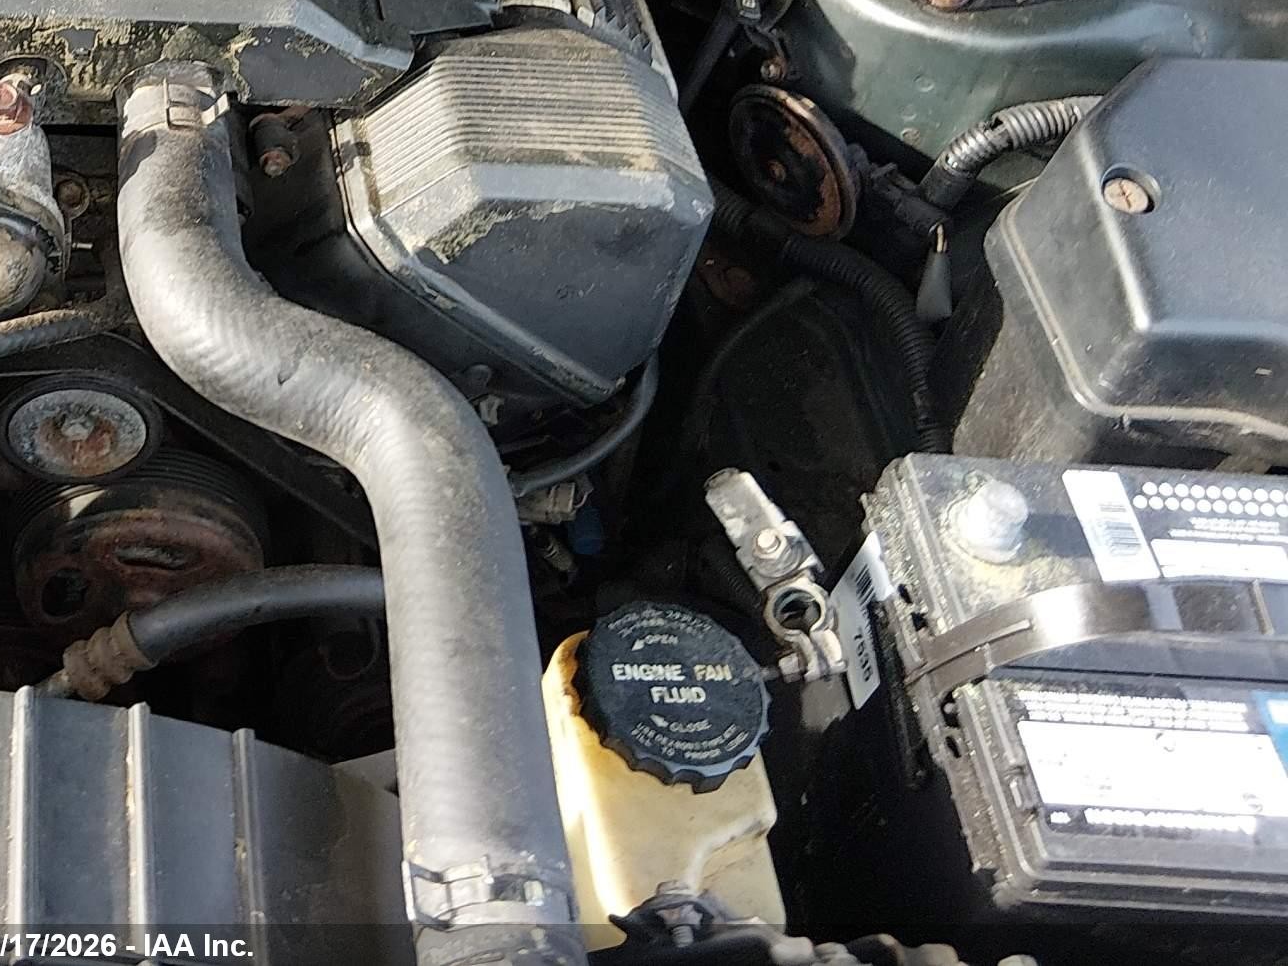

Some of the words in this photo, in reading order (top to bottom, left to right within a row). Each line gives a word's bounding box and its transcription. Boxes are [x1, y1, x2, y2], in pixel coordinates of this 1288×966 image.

[611, 663, 686, 682] ENGINE
[693, 663, 733, 682] FAN
[650, 686, 707, 704] FLUID
